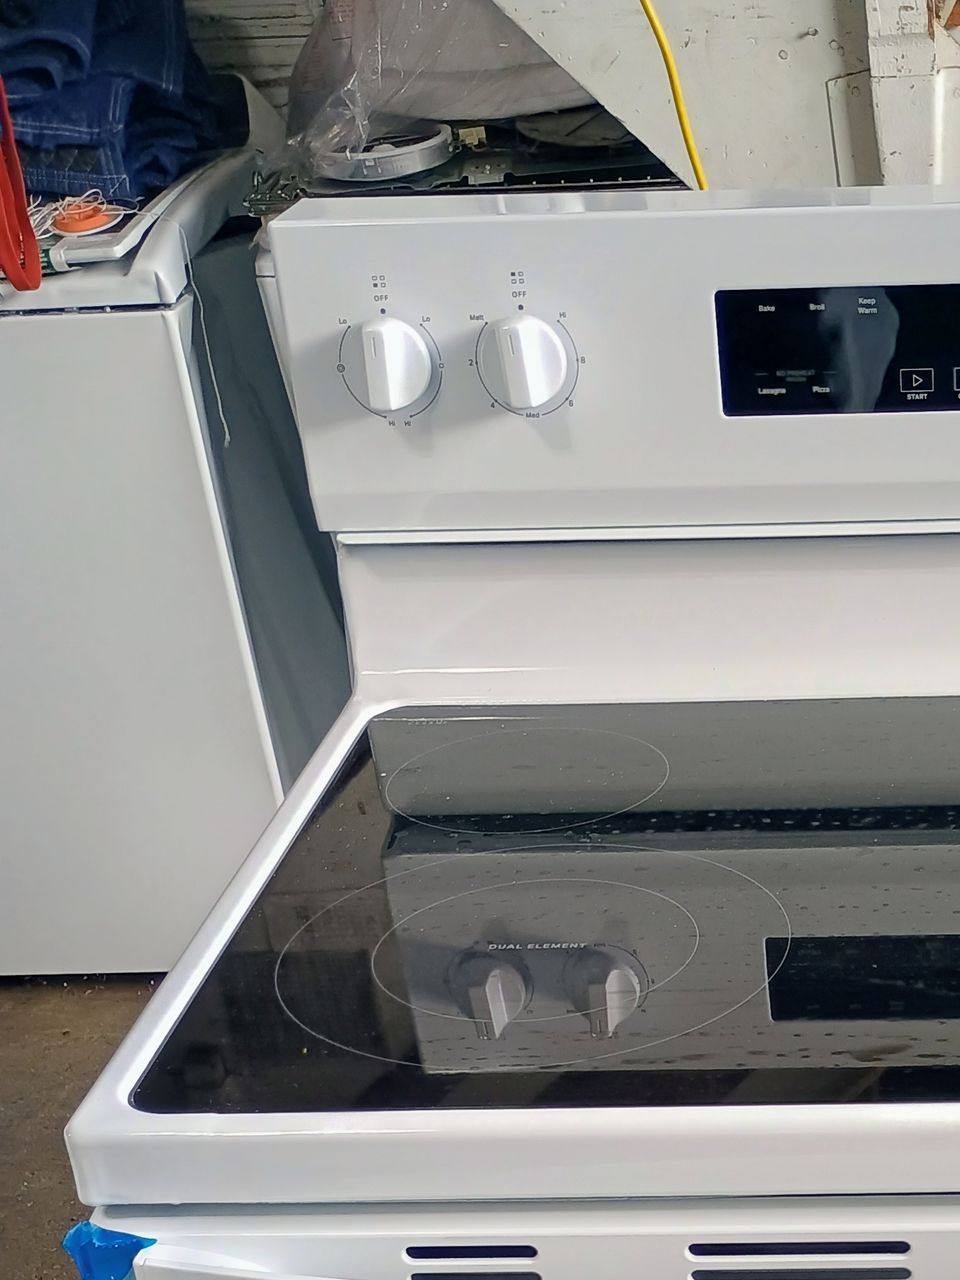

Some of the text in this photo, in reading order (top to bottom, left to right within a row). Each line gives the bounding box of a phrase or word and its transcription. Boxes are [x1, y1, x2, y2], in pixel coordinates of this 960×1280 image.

[374, 294, 389, 302] OFF
[858, 297, 876, 305] Keep
[338, 317, 348, 325] Lo
[422, 315, 431, 323] Lo
[488, 942, 588, 951] DUAL ELEMENT
